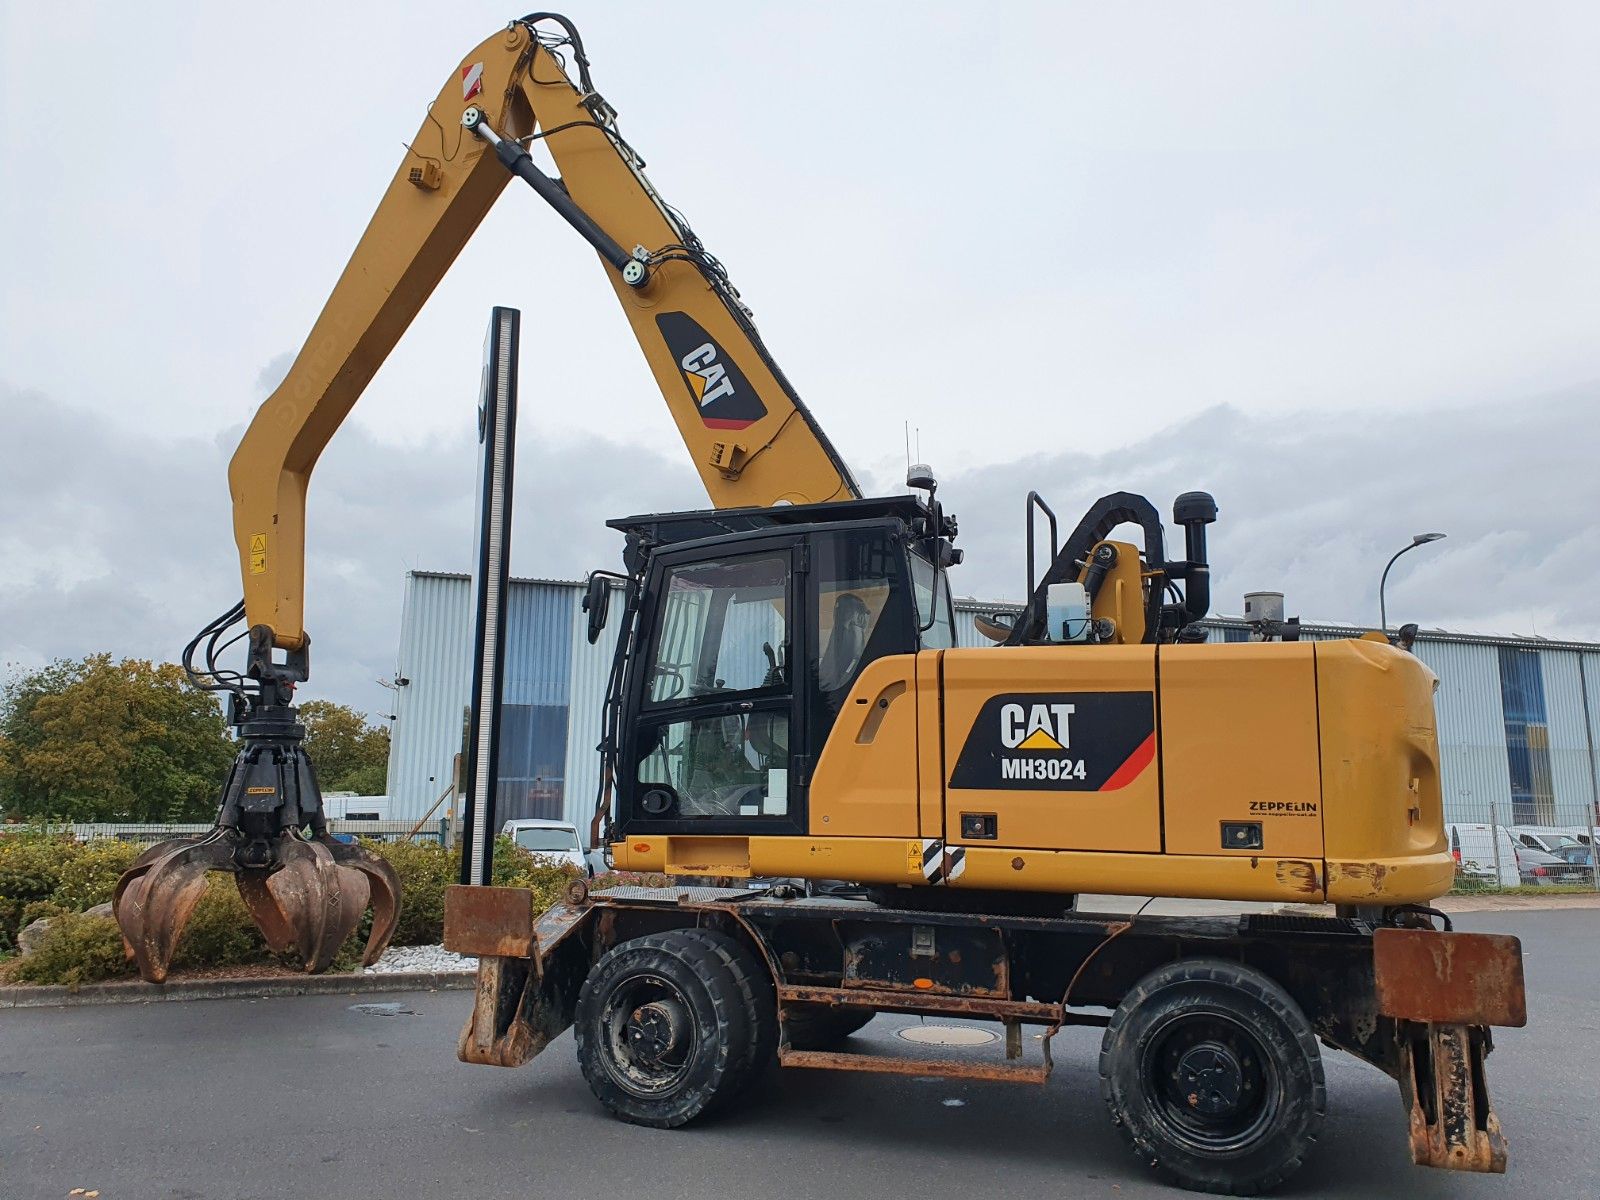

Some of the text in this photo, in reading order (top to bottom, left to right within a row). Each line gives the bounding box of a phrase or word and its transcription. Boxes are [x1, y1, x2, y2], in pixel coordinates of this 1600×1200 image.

[682, 342, 735, 407] CAT
[1001, 703, 1075, 749] CAT
[1002, 759, 1087, 780] MH3024
[1249, 801, 1317, 811] ZEPPELIN
